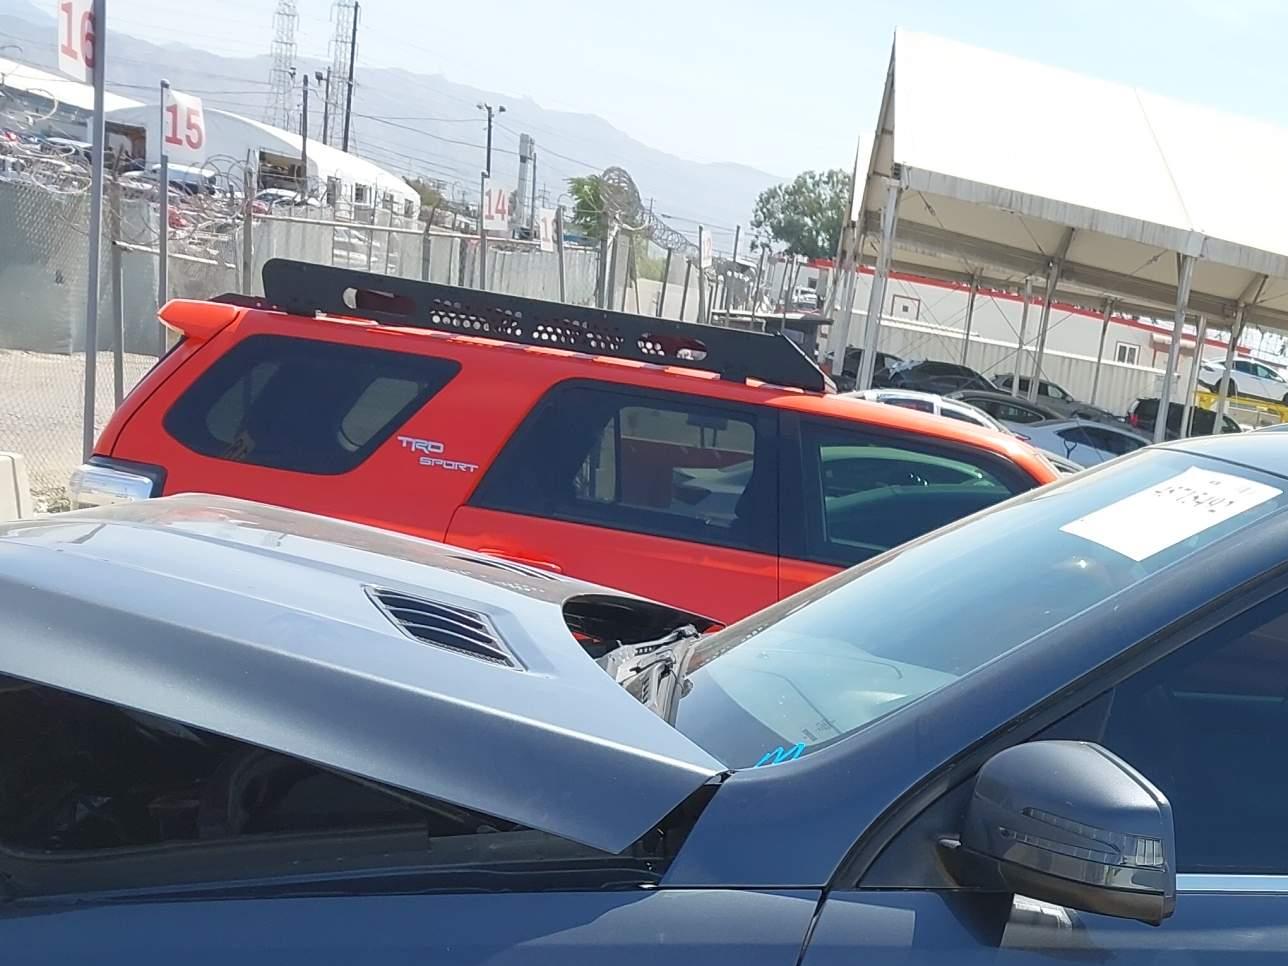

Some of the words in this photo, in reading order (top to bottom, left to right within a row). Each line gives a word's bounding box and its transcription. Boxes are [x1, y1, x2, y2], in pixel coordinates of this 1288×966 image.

[165, 104, 203, 149] 15
[485, 189, 506, 220] 14
[397, 436, 444, 454] TRD
[419, 456, 479, 473] SPORT
